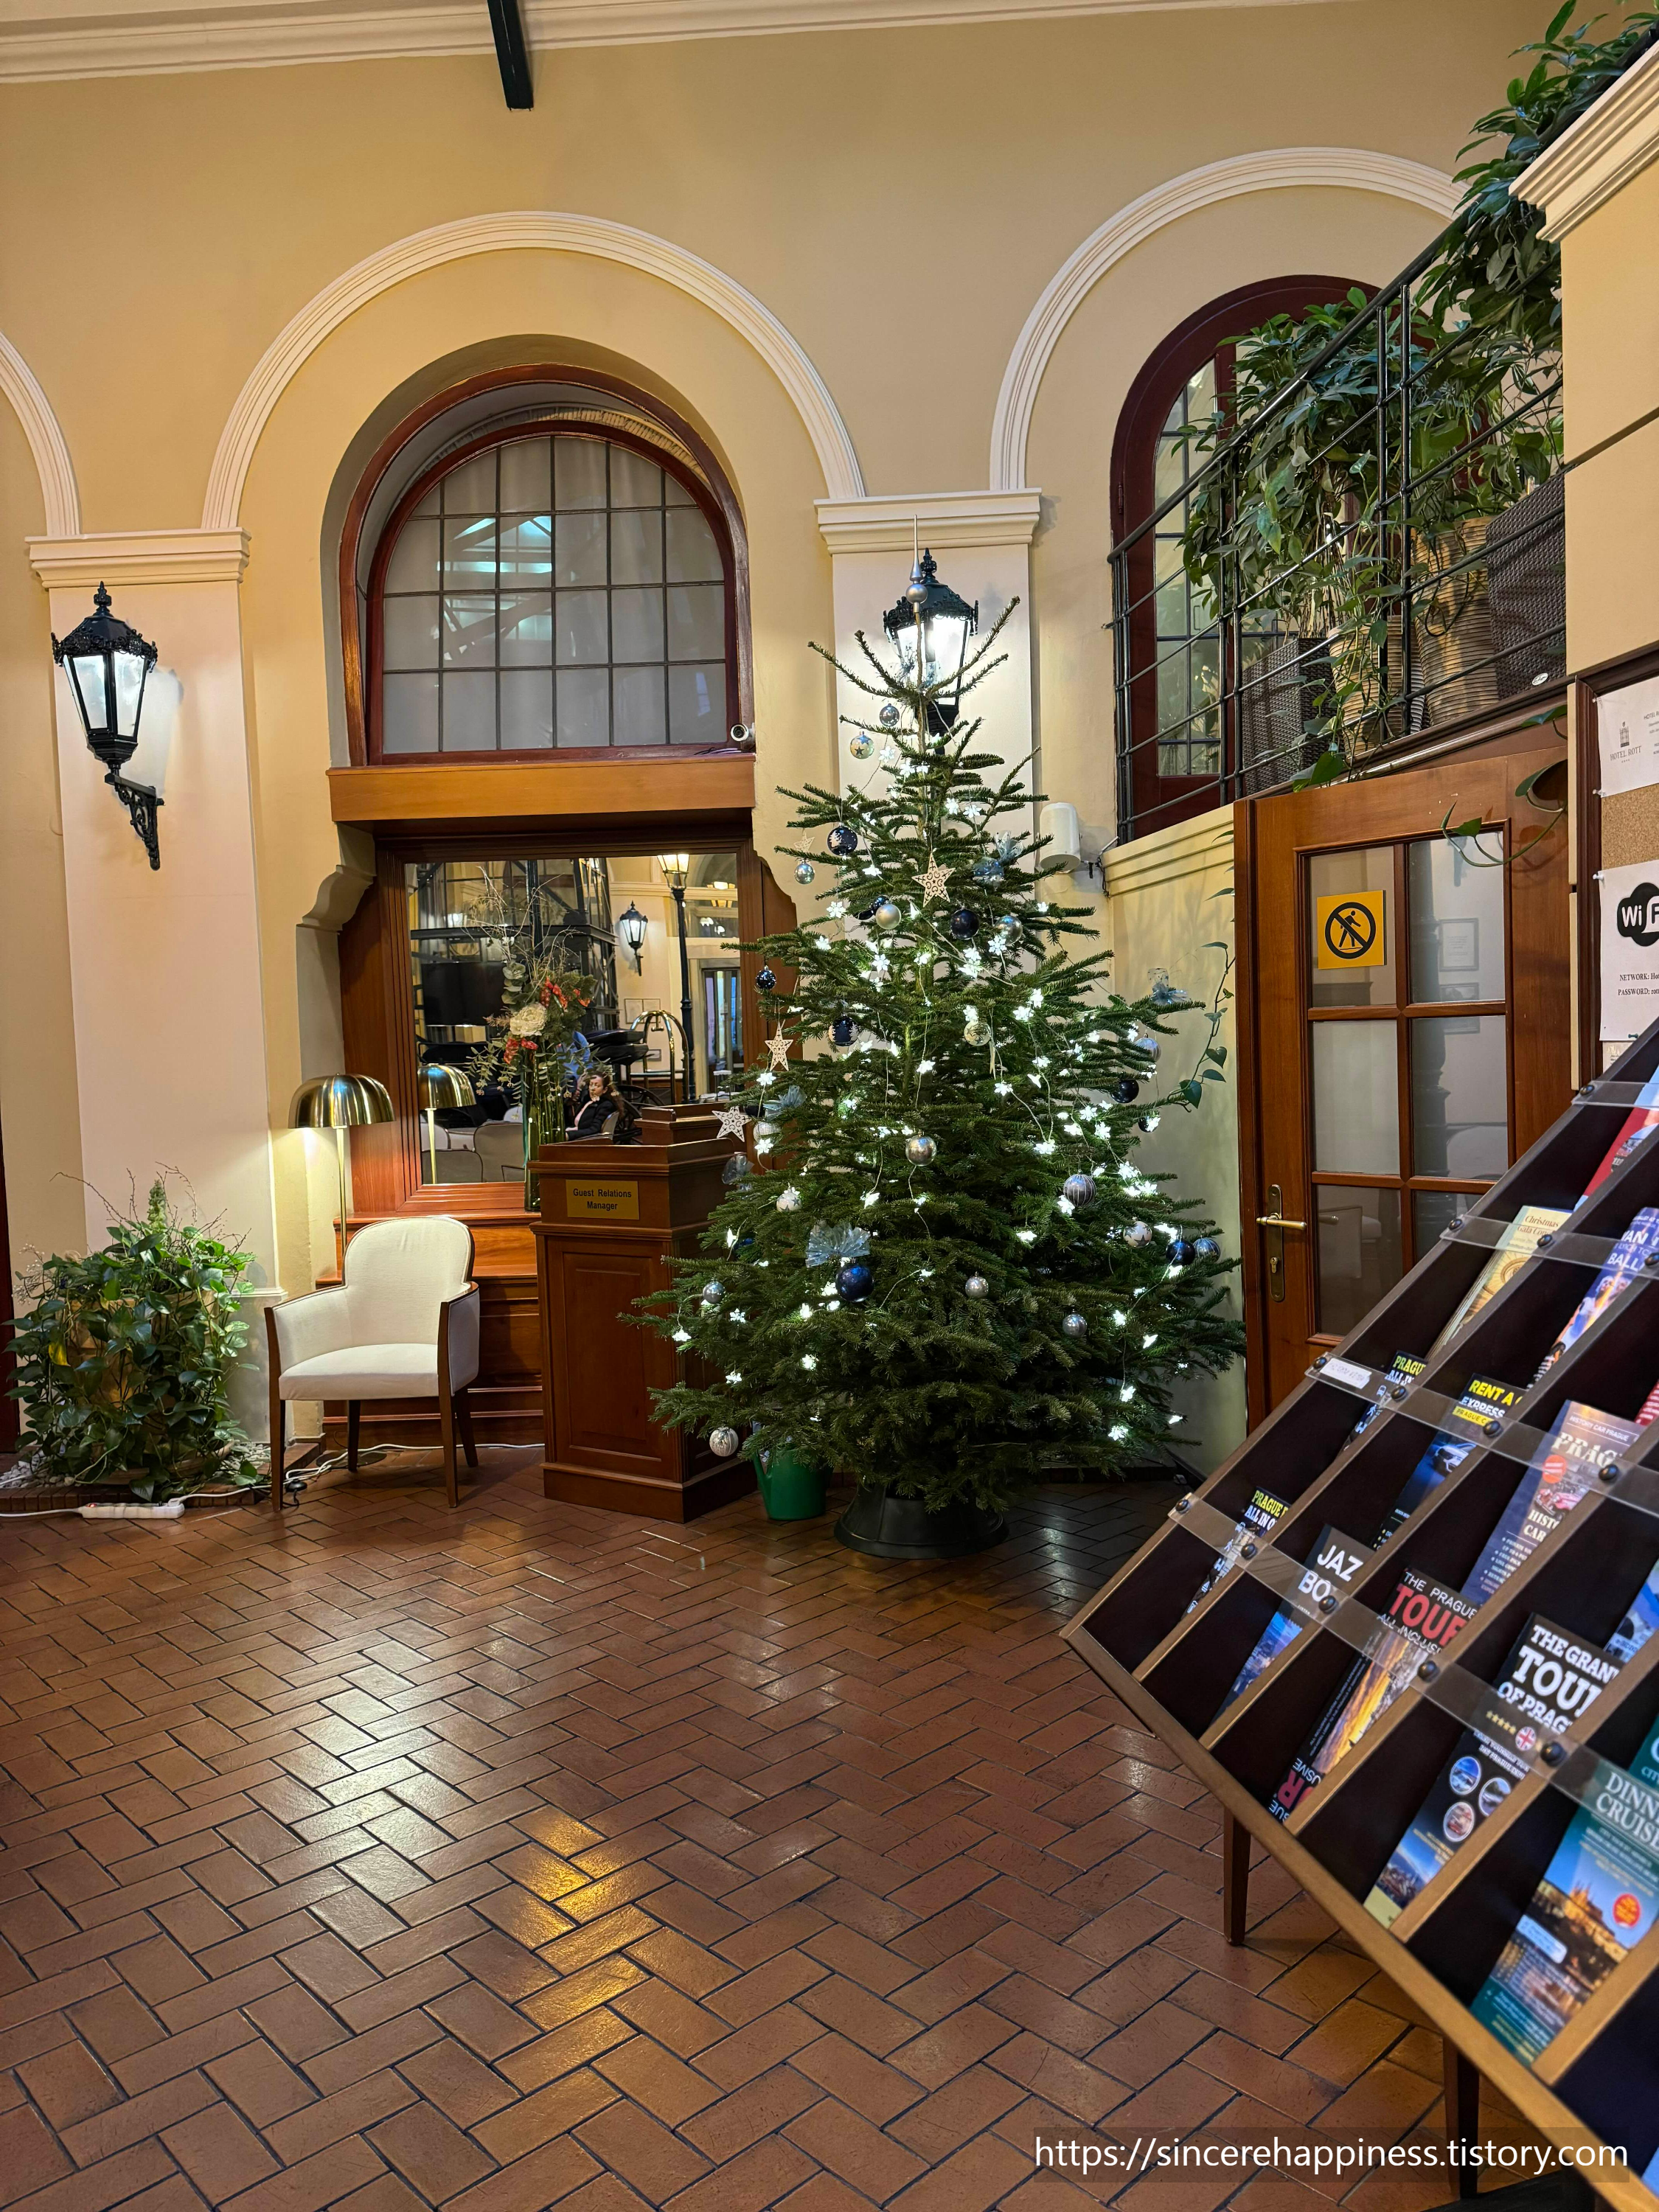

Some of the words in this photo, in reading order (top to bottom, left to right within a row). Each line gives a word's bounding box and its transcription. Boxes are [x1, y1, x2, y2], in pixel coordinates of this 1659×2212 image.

[1610, 750, 1627, 761] HOTEL
[1628, 745, 1642, 757] ROTT
[1620, 973, 1649, 981] NETWORK:
[1618, 987, 1650, 995] PASSWORD:
[573, 1189, 594, 1197] Guest
[598, 1189, 632, 1198] Relations
[587, 1201, 618, 1211] Manager
[1525, 1215, 1559, 1228] Christmas
[1607, 1252, 1645, 1272] BALL
[1468, 1380, 1506, 1401] RENT
[1501, 1392, 1514, 1406] A
[1455, 1408, 1480, 1422] PRAGUE
[1458, 1397, 1506, 1419] EXPRESS
[1569, 1415, 1593, 1428] HISTORY
[1593, 1425, 1606, 1433] CAR
[1606, 1429, 1630, 1441] PRAGUE
[1551, 1432, 1623, 1468] PRAG
[1251, 1490, 1282, 1517] PRAGUE
[1244, 1505, 1259, 1523] ALL
[1258, 1509, 1273, 1528] IN
[1523, 1525, 1547, 1543] CAR
[1404, 1572, 1427, 1591] THE
[1377, 1613, 1397, 1630] ALL
[1531, 1624, 1569, 1658] THE
[1565, 1645, 1619, 1684] GRAN
[1497, 1681, 1526, 1705] OF
[1517, 1694, 1573, 1735] PRAG
[1605, 1772, 1659, 1823] DINN
